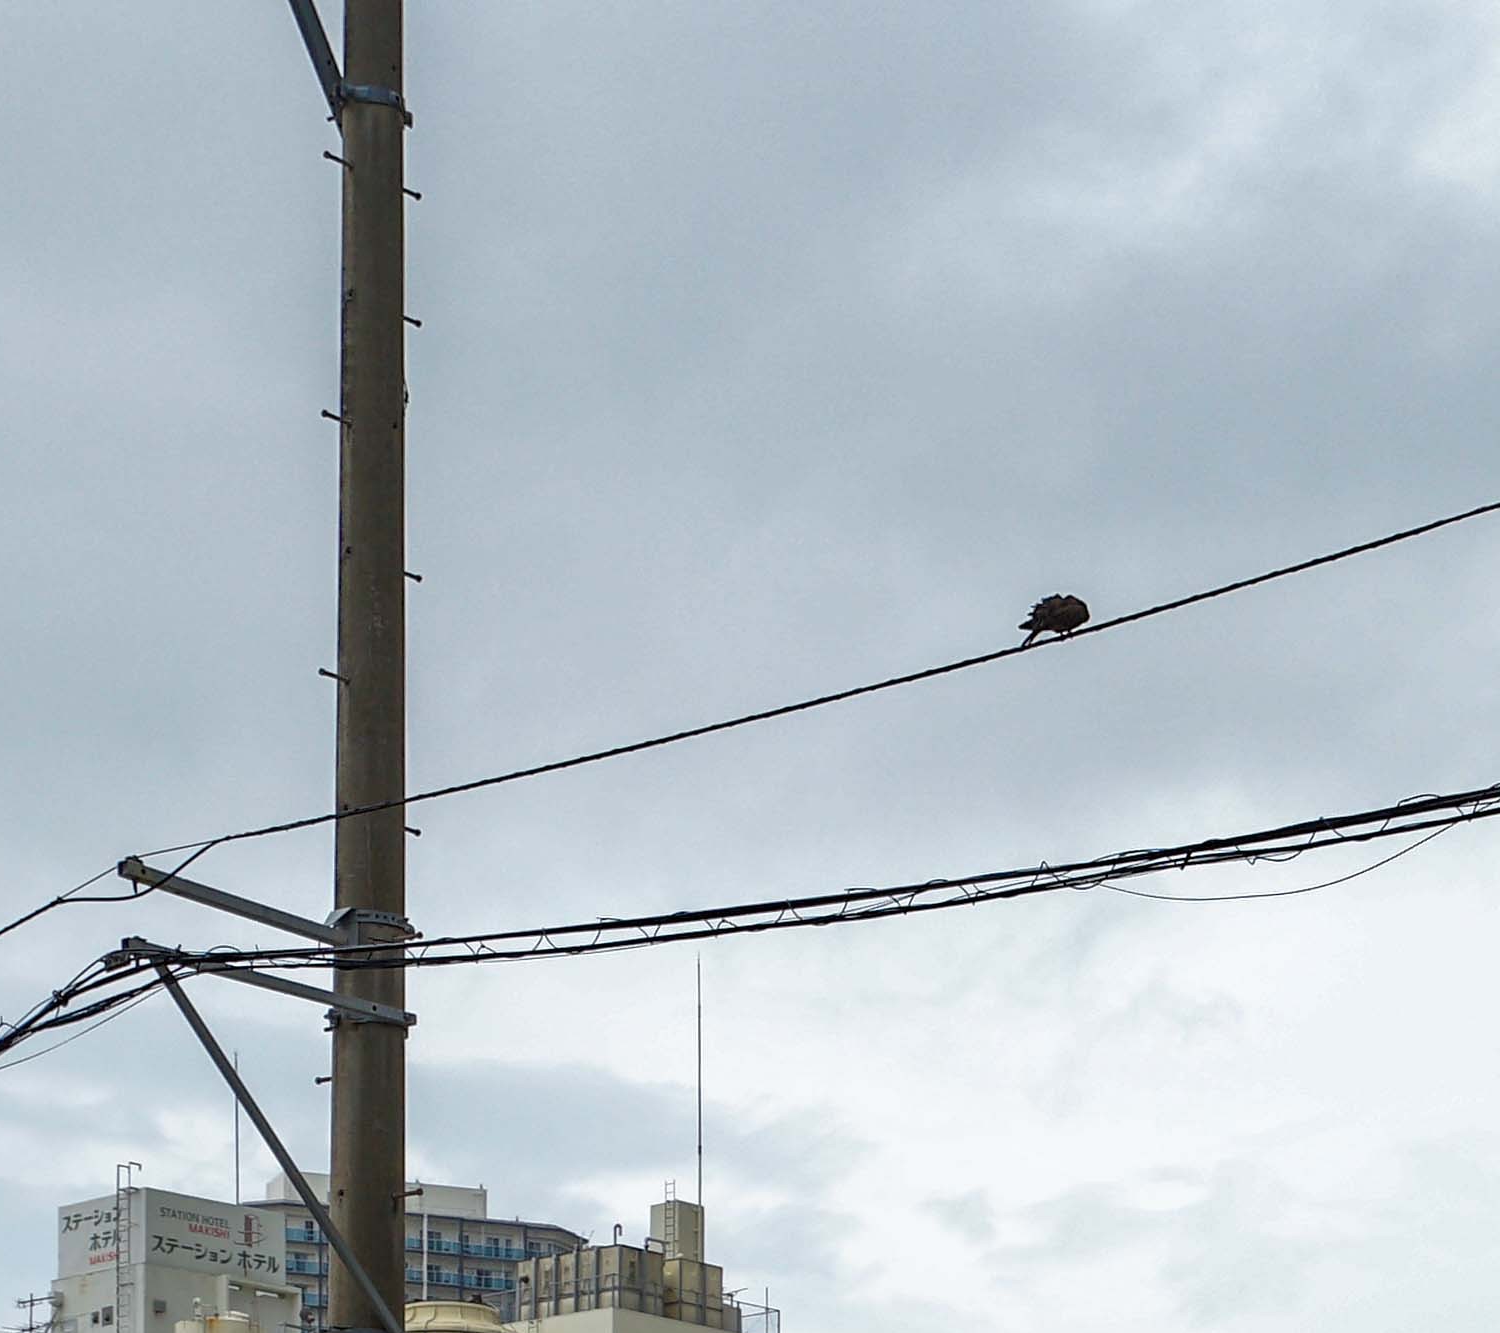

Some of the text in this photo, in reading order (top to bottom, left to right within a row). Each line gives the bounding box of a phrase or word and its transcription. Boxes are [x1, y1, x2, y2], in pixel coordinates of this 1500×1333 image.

[160, 1206, 229, 1228] STATION HOTEL
[151, 1234, 280, 1274] ステーション ホテル
